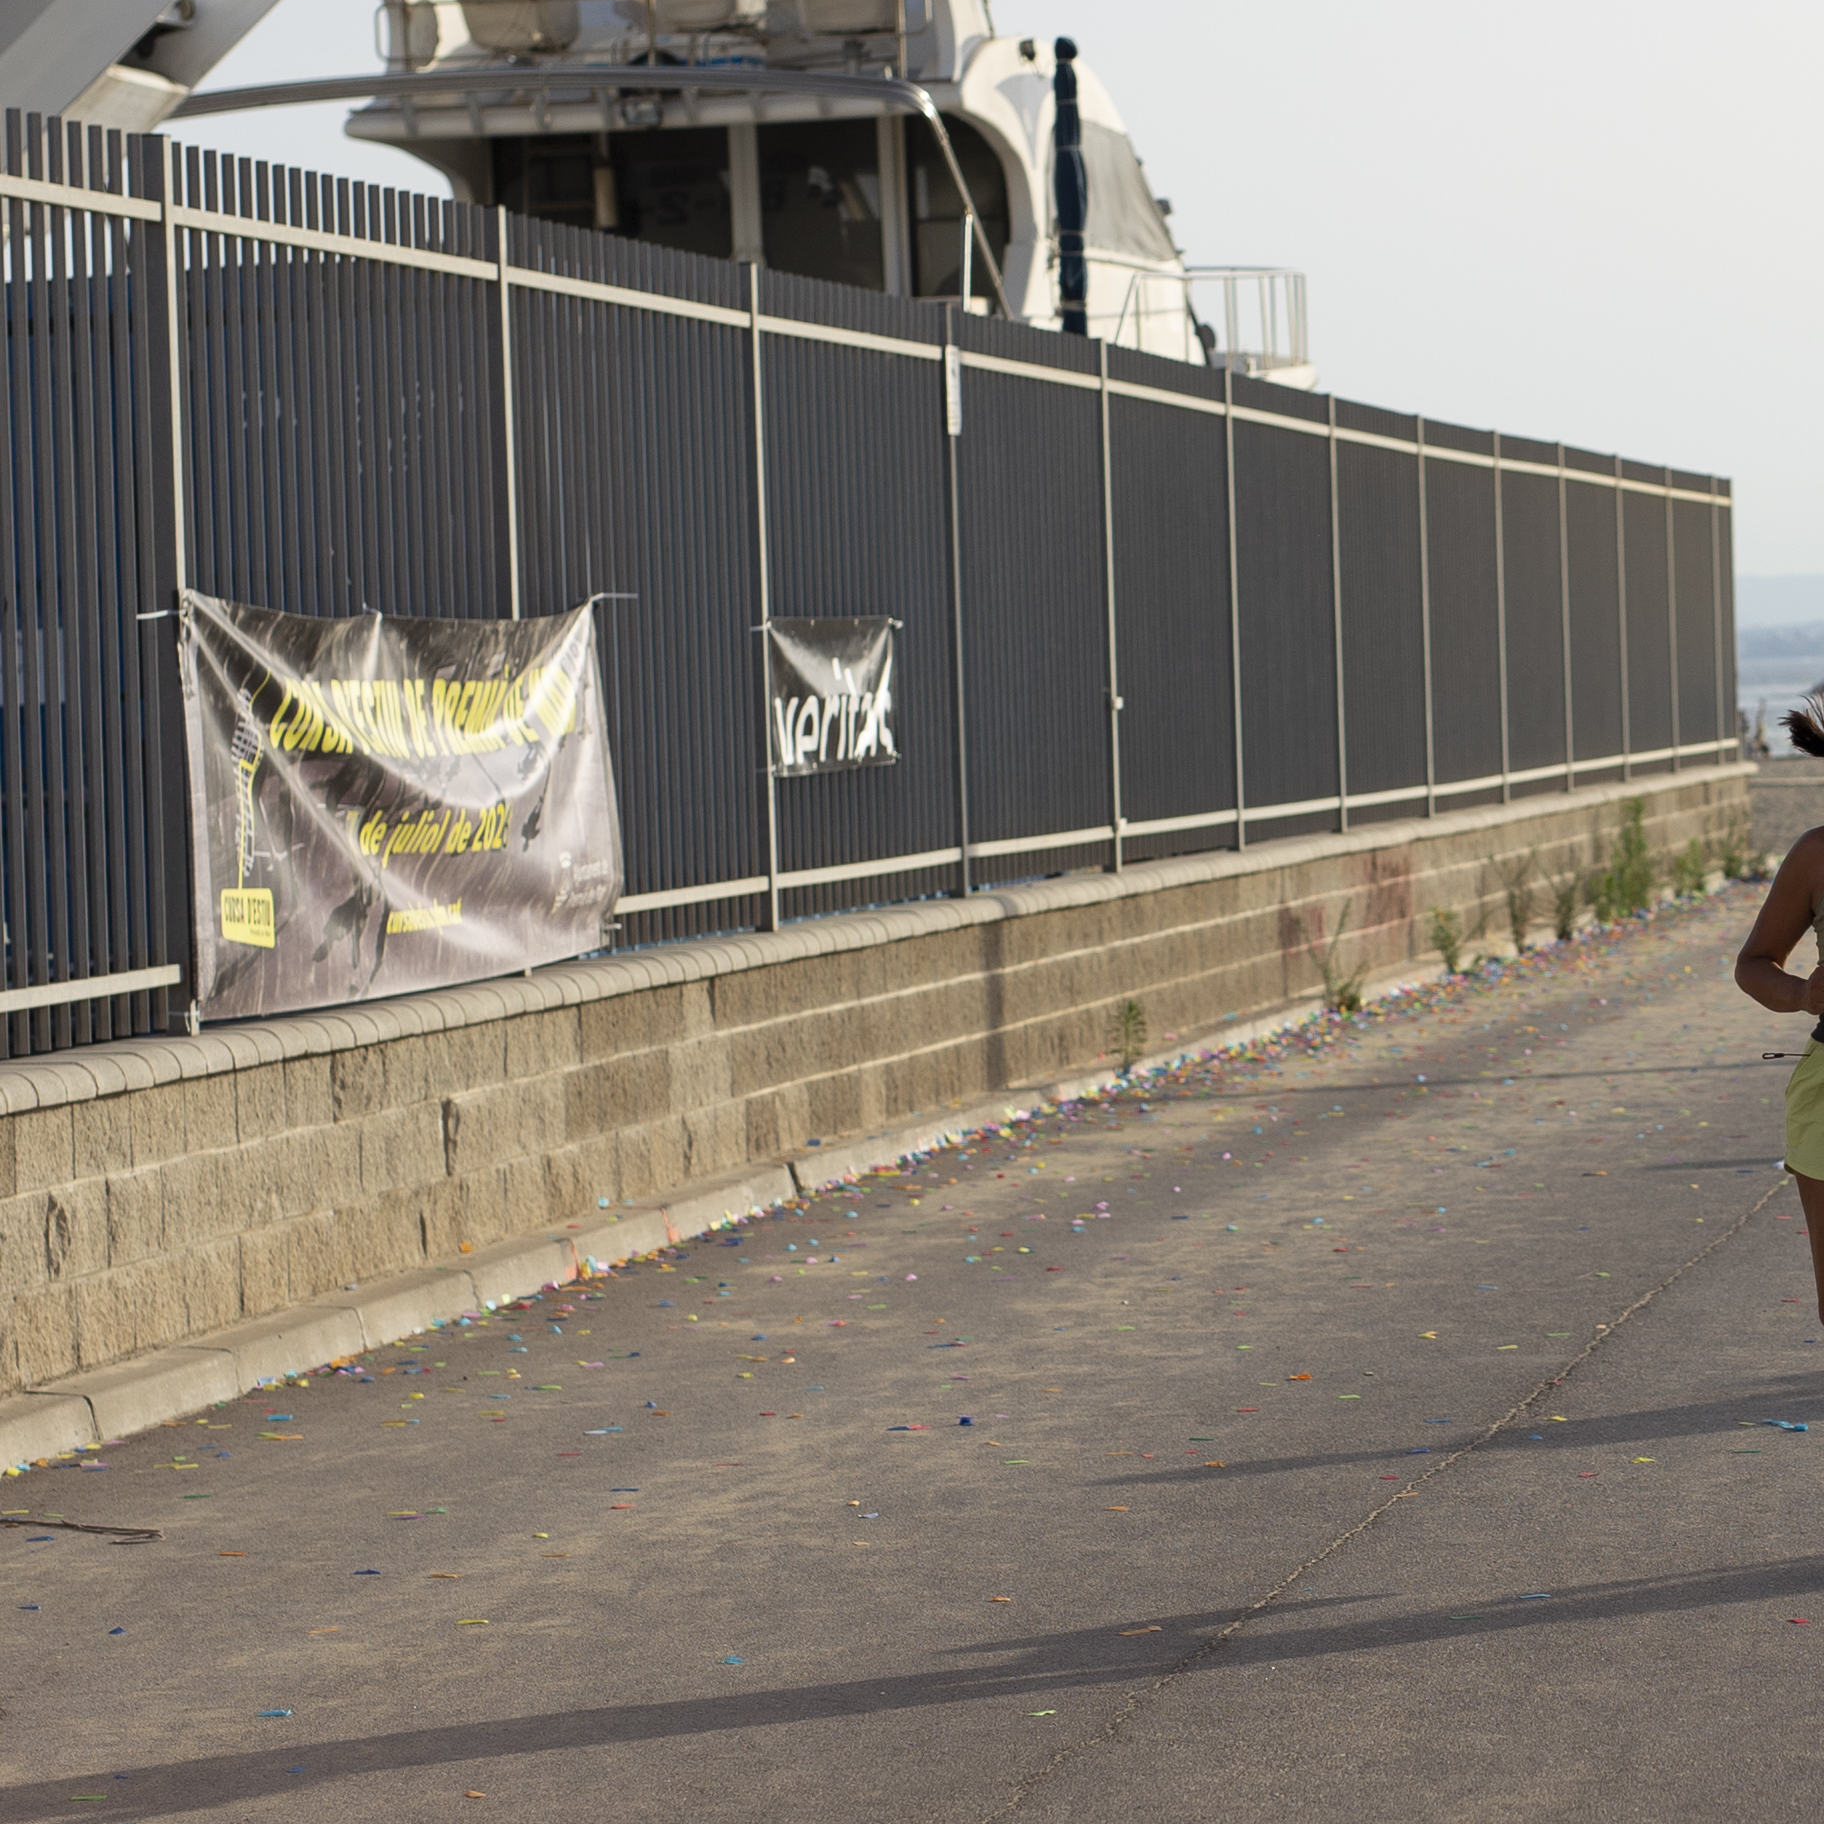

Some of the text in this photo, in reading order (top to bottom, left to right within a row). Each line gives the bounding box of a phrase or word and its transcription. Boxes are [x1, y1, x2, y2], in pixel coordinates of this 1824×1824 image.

[404, 678, 437, 759] DE
[433, 663, 509, 757] PREMIÀ
[360, 809, 387, 857] de
[382, 809, 451, 869] juliol
[445, 807, 472, 854] de
[470, 802, 512, 853] 202
[225, 896, 271, 927] CURSA D'ESTIU
